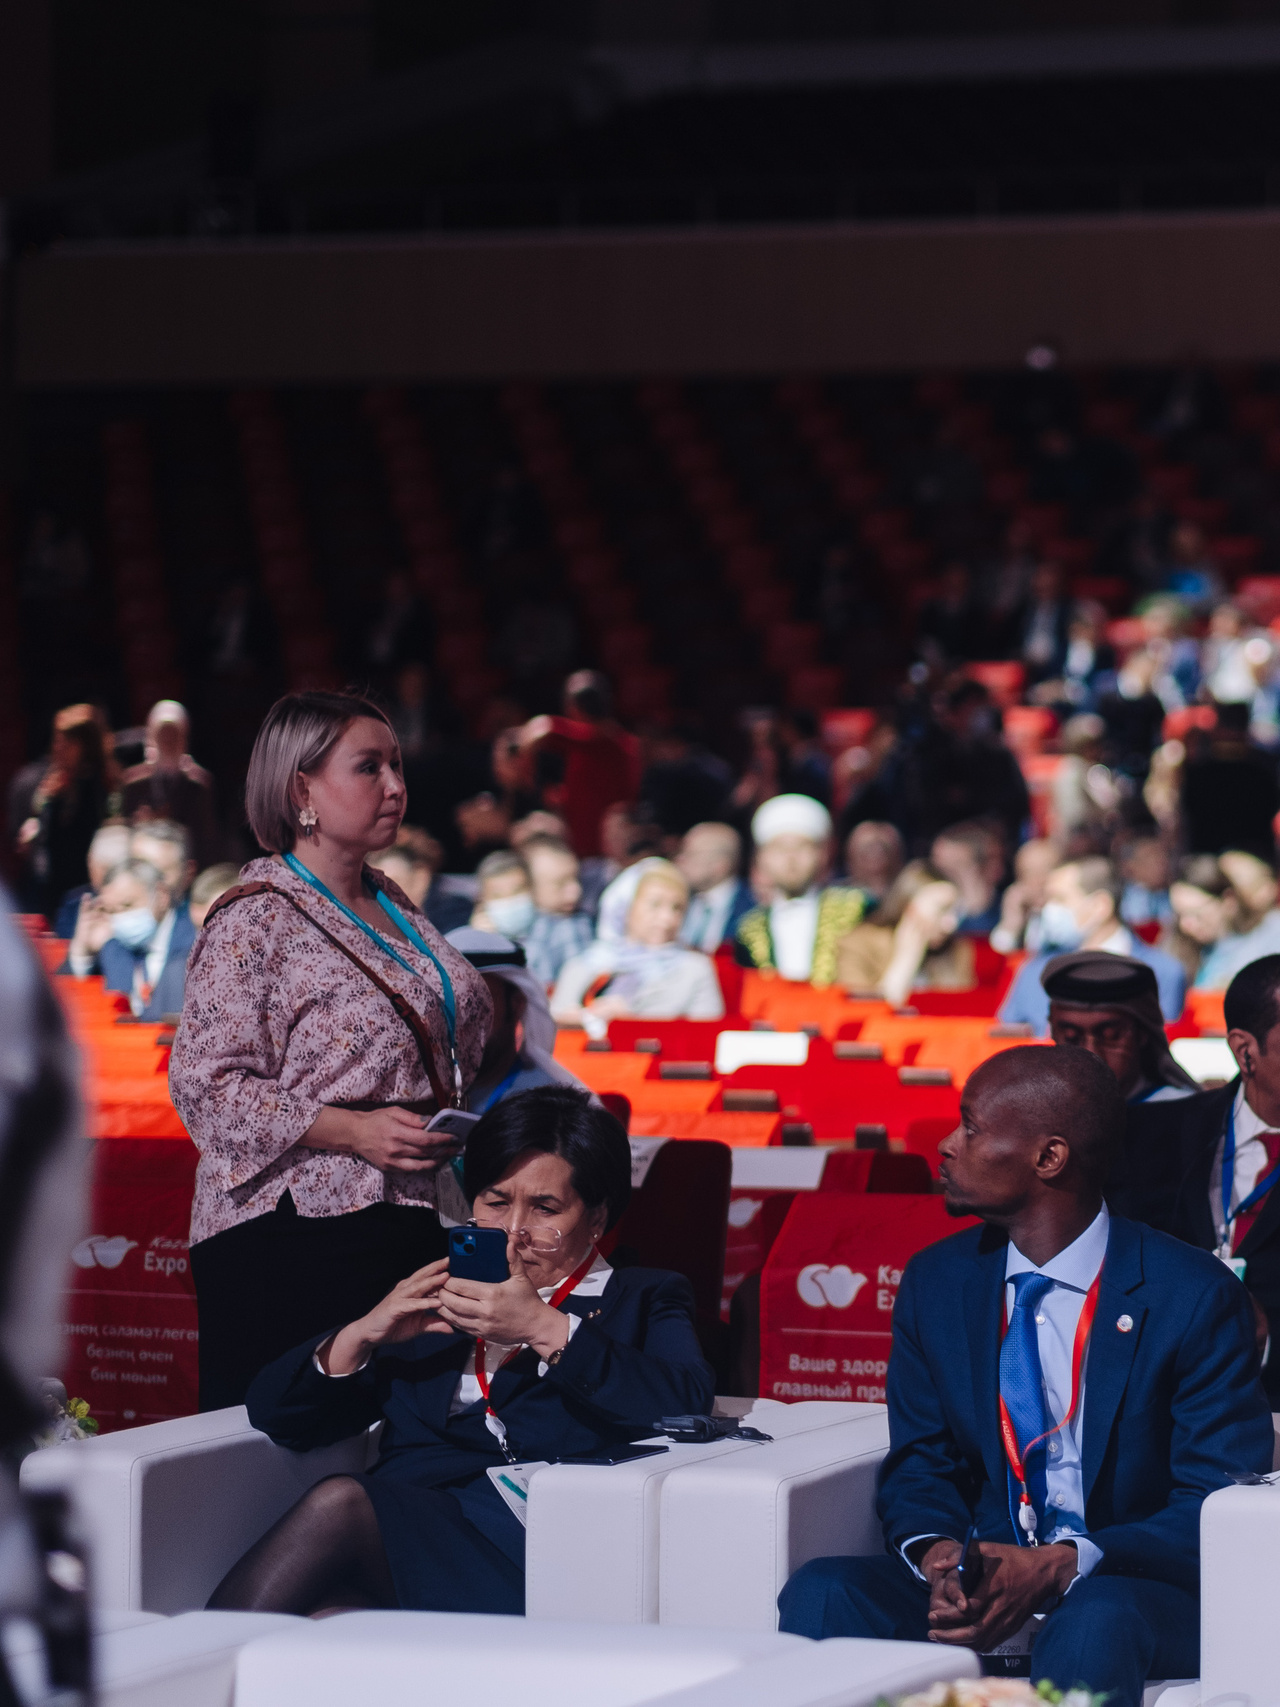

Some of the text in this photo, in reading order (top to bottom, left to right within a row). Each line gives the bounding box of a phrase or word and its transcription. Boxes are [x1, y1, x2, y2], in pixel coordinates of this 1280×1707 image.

[144, 1251, 188, 1276] Expo
[788, 1353, 888, 1377] Ваше здор
[773, 1380, 852, 1398] главный
[1004, 1658, 1021, 1668] VIP
